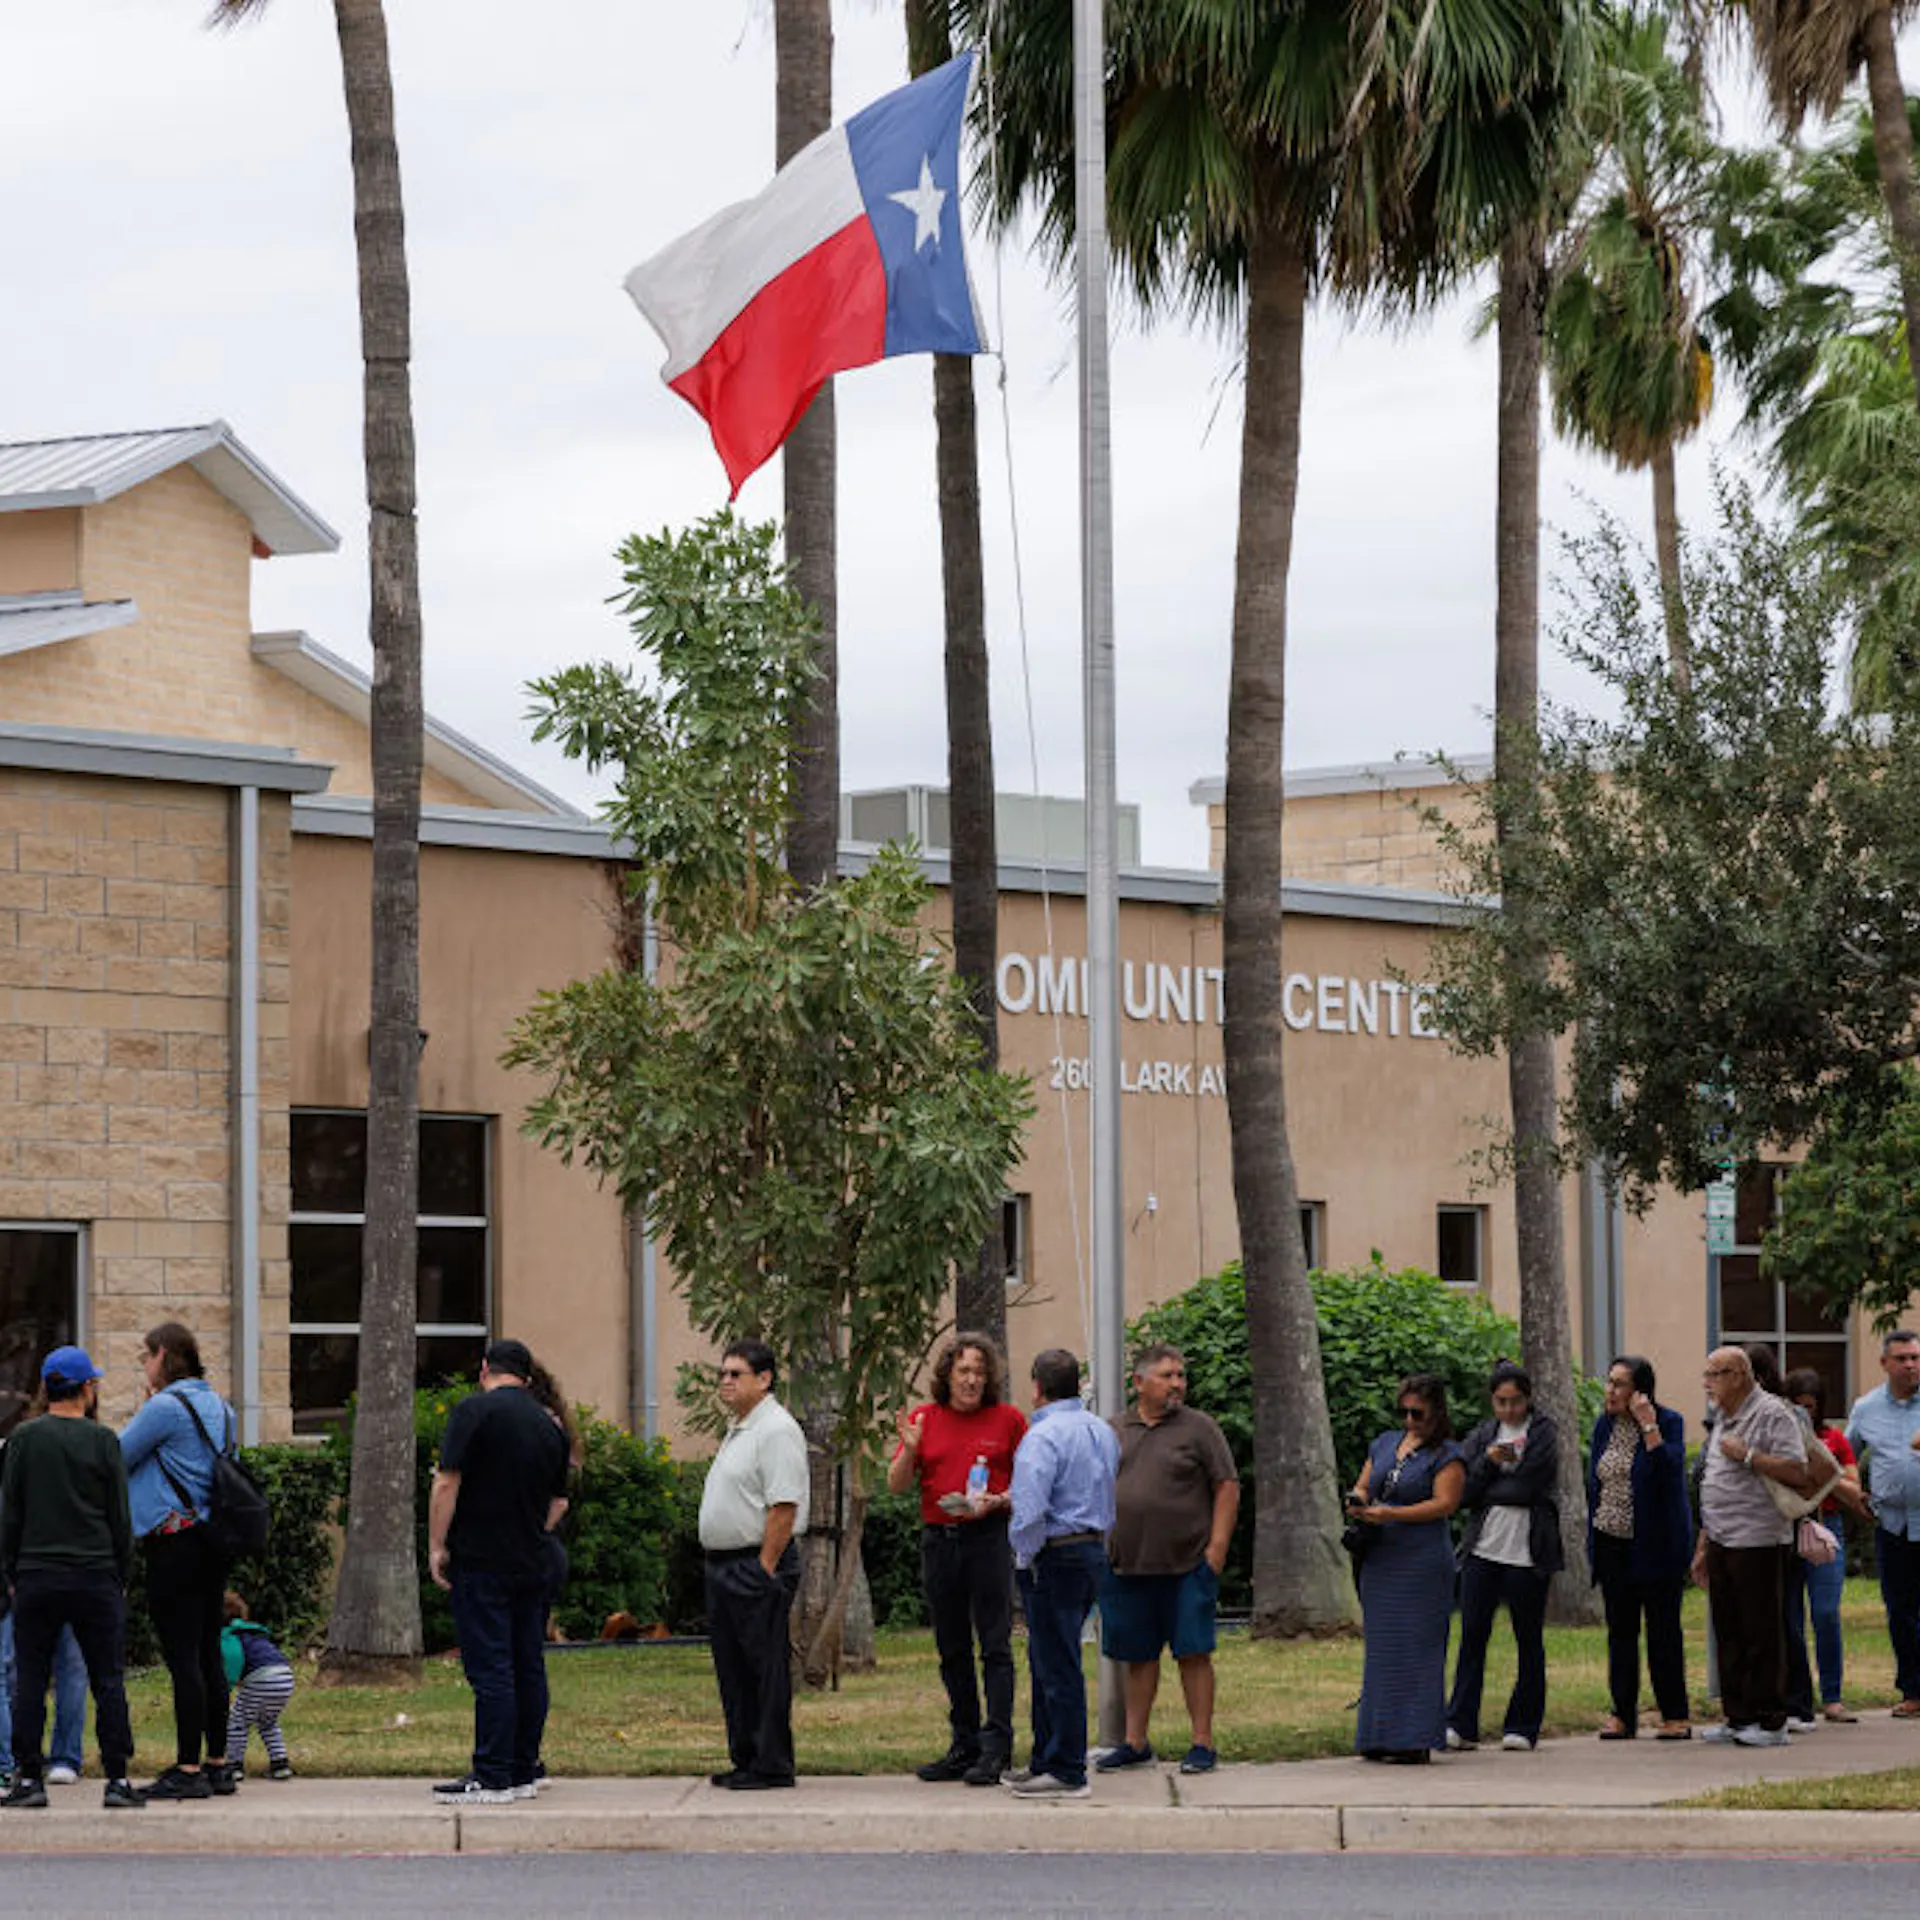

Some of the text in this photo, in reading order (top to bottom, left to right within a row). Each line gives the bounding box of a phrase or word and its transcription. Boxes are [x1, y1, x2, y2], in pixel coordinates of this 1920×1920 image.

[995, 951, 1225, 1026] OMUNIT
[1283, 973, 1453, 1039] CENTE
[1120, 1060, 1193, 1096] LARK
